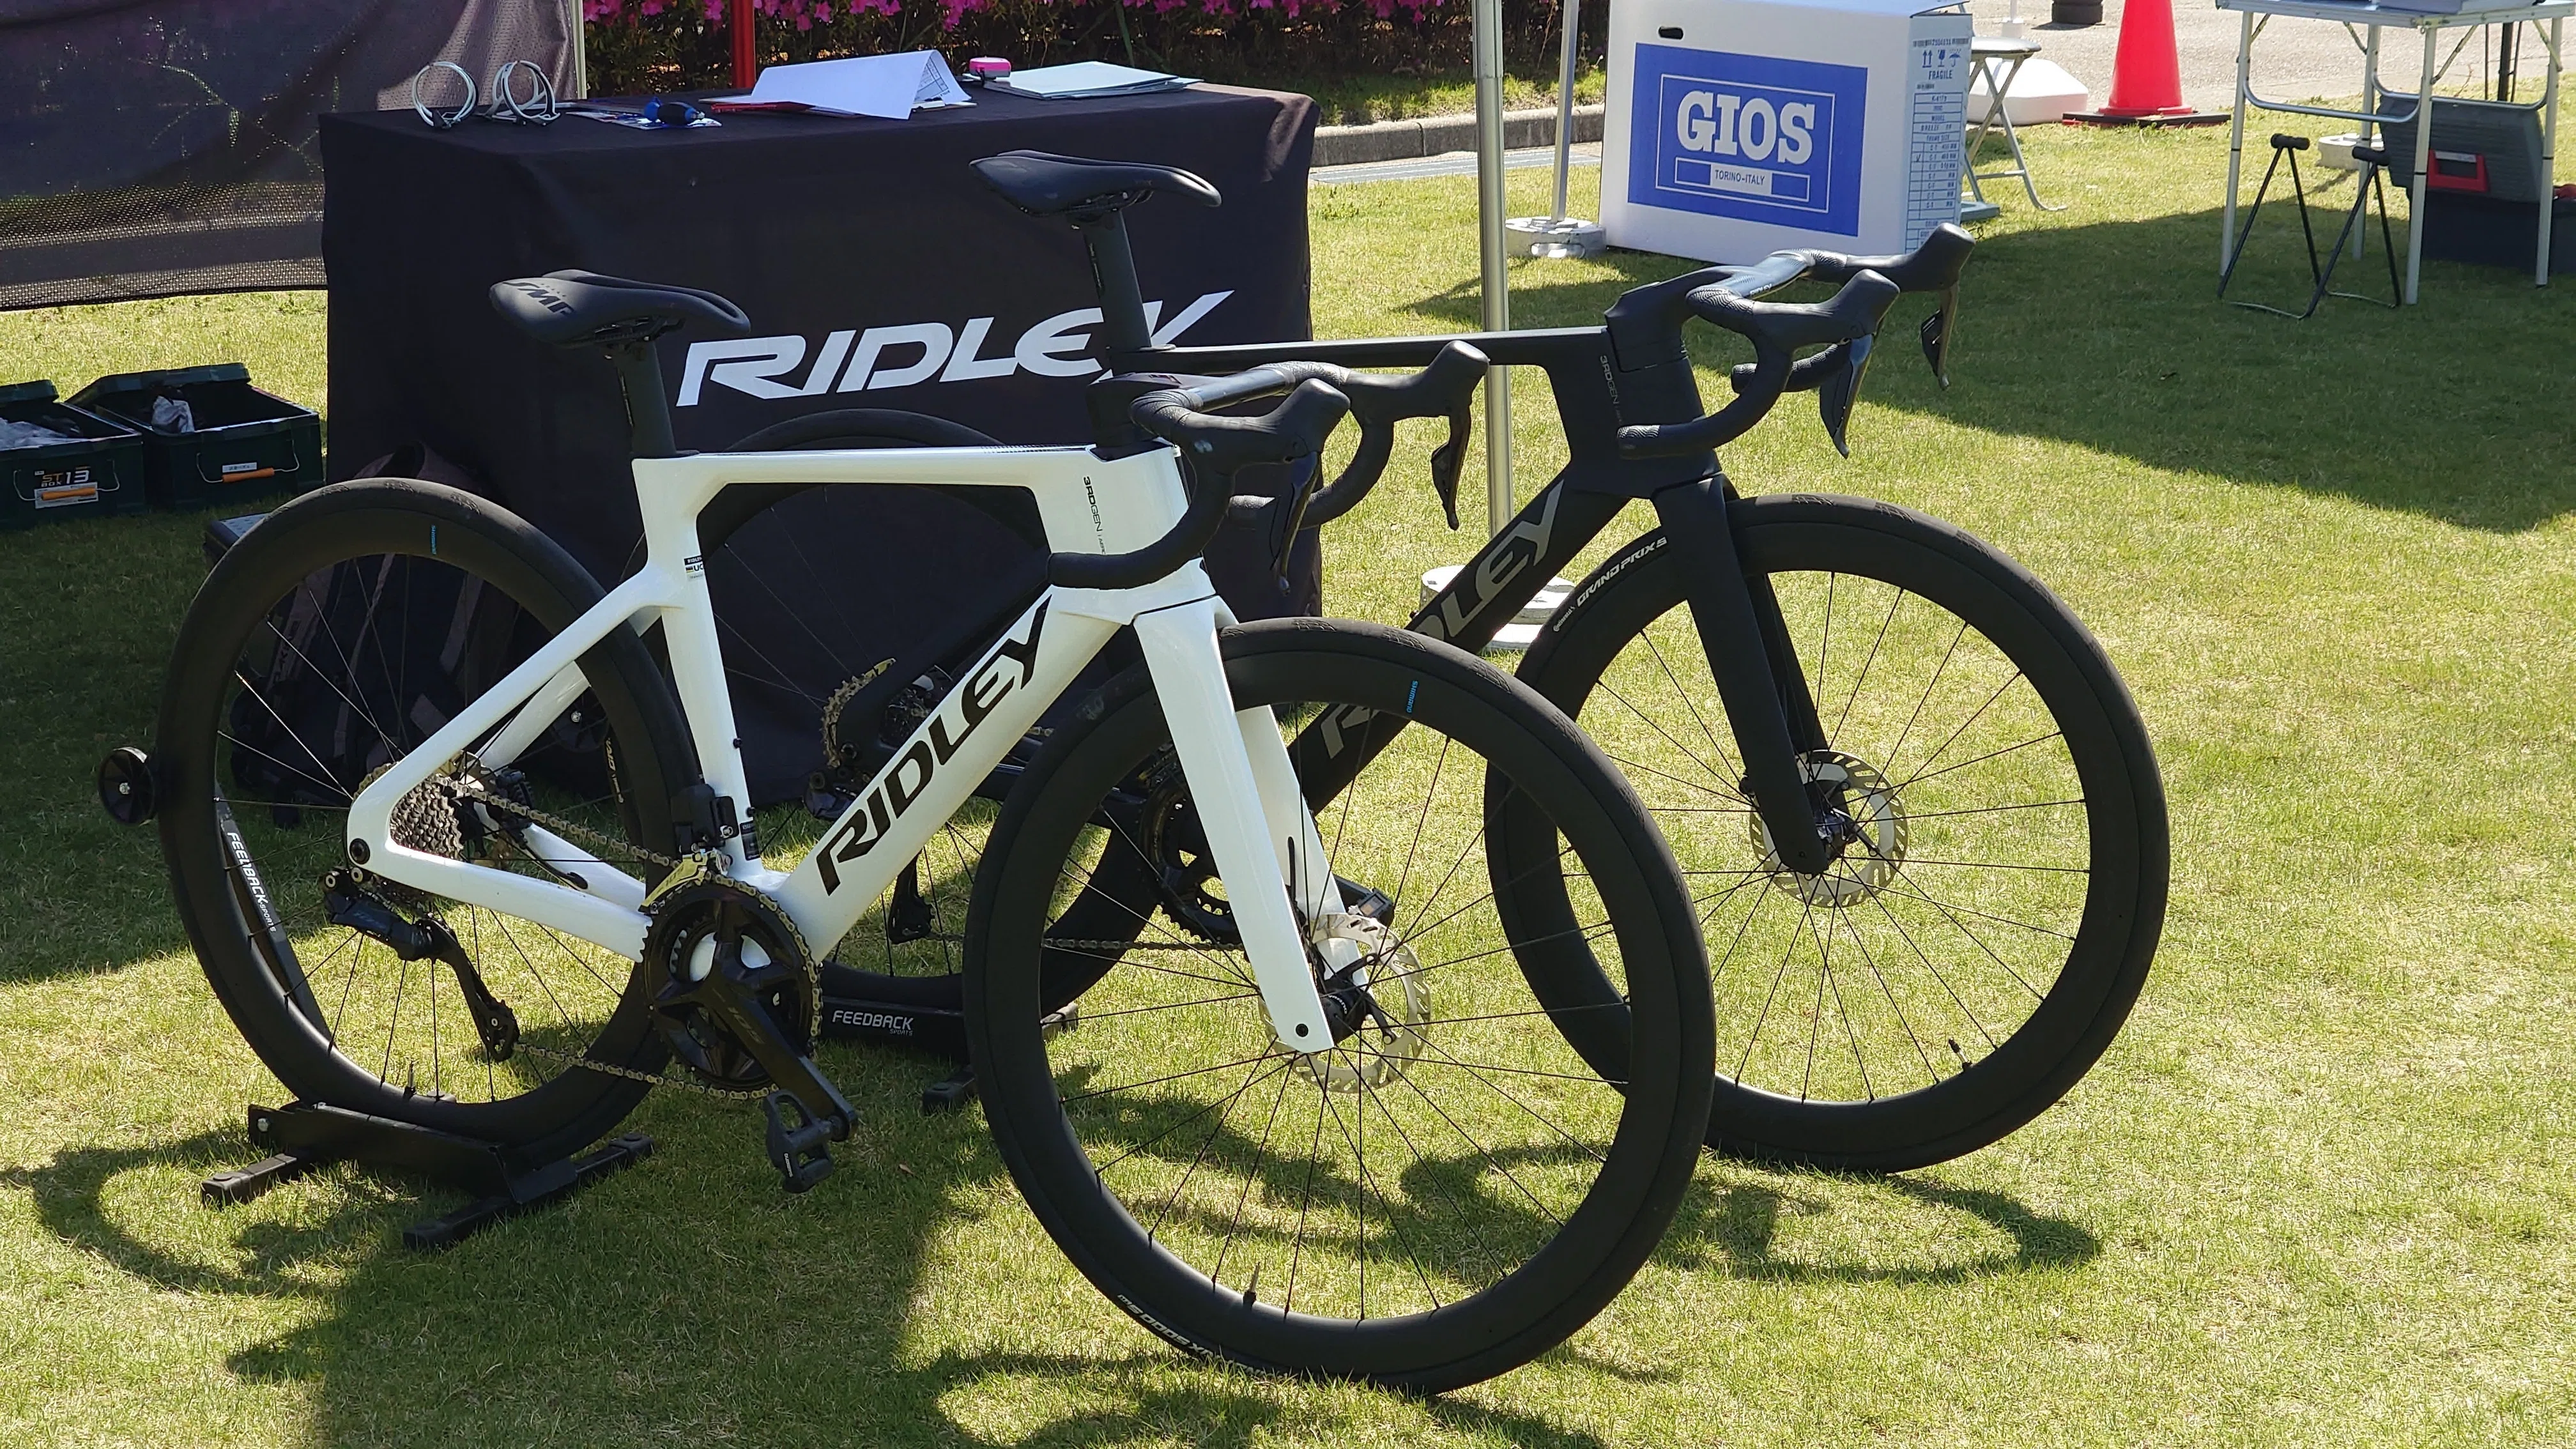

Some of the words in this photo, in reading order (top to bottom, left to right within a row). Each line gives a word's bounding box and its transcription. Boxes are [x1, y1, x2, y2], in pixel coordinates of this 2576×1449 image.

[1928, 70, 1953, 80] FRAGILE
[1677, 90, 1816, 165] GIOS
[1715, 169, 1765, 186] TORINO-ITALY
[502, 282, 574, 316] SMP
[676, 289, 1235, 407] RIDLEY
[42, 473, 64, 483] ST
[66, 470, 89, 484] 13
[1084, 476, 1103, 532] 3RDGEN
[1577, 564, 1620, 607] GRAND
[1620, 542, 1655, 570] PRIX
[1321, 479, 1565, 759] RLEY
[1406, 680, 1418, 713] SHIMANO
[816, 594, 1052, 896] RIDLEY
[227, 832, 268, 903] FEEDBACK
[832, 1010, 914, 1031] FEEDBACK
[889, 1028, 914, 1036] SPORTS
